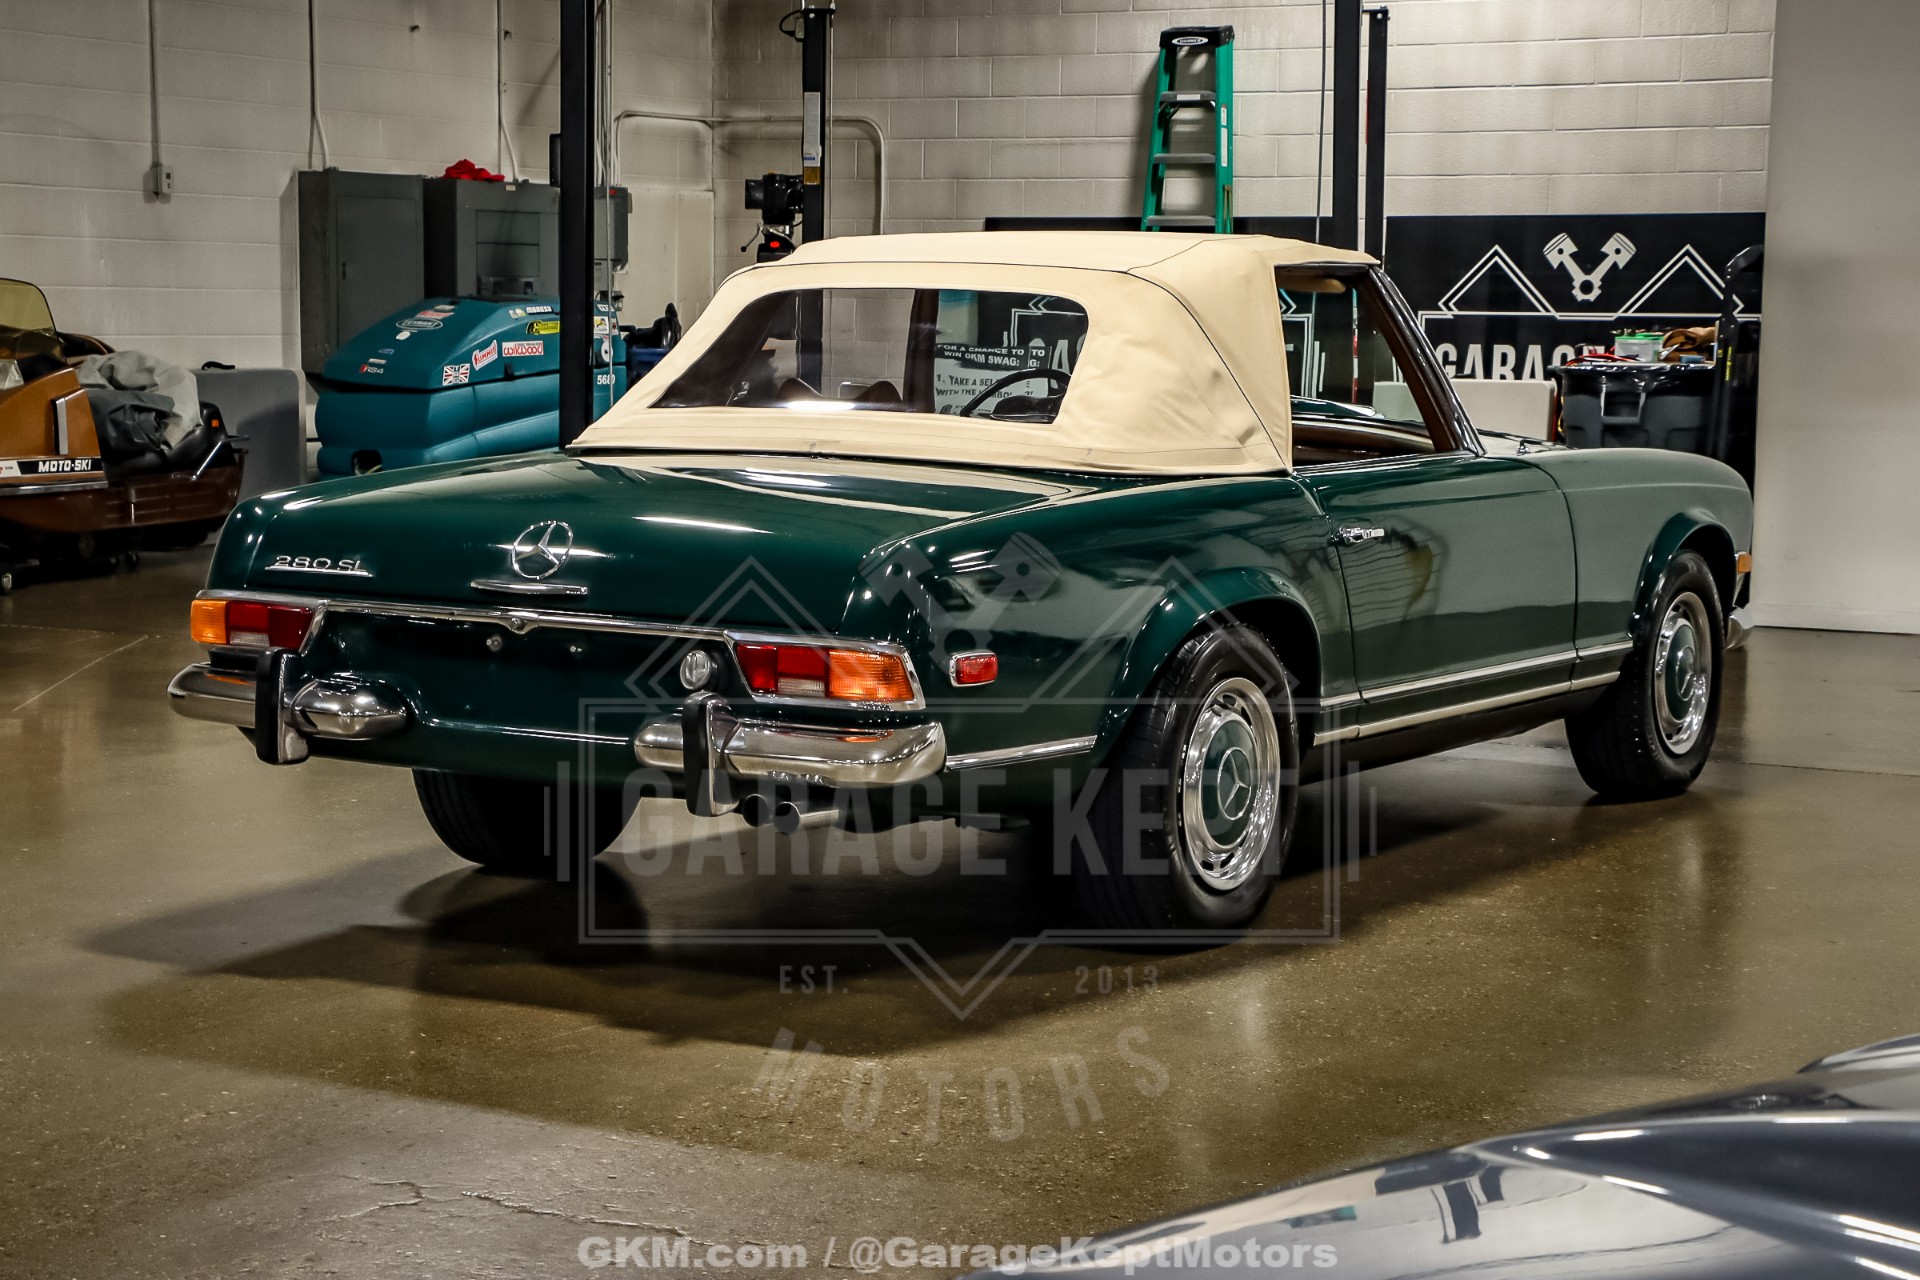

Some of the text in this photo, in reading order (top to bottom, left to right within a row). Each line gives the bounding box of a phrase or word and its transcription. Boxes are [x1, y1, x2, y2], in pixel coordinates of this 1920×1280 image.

[968, 347, 1009, 355] CHANCE
[1031, 349, 1045, 357] TO
[943, 350, 962, 358] WIN
[964, 352, 986, 364] GKM
[948, 374, 971, 386] TAKE
[971, 377, 978, 386] A
[935, 387, 959, 396] WITH
[961, 389, 977, 397] THE
[274, 555, 367, 572] 280 SL
